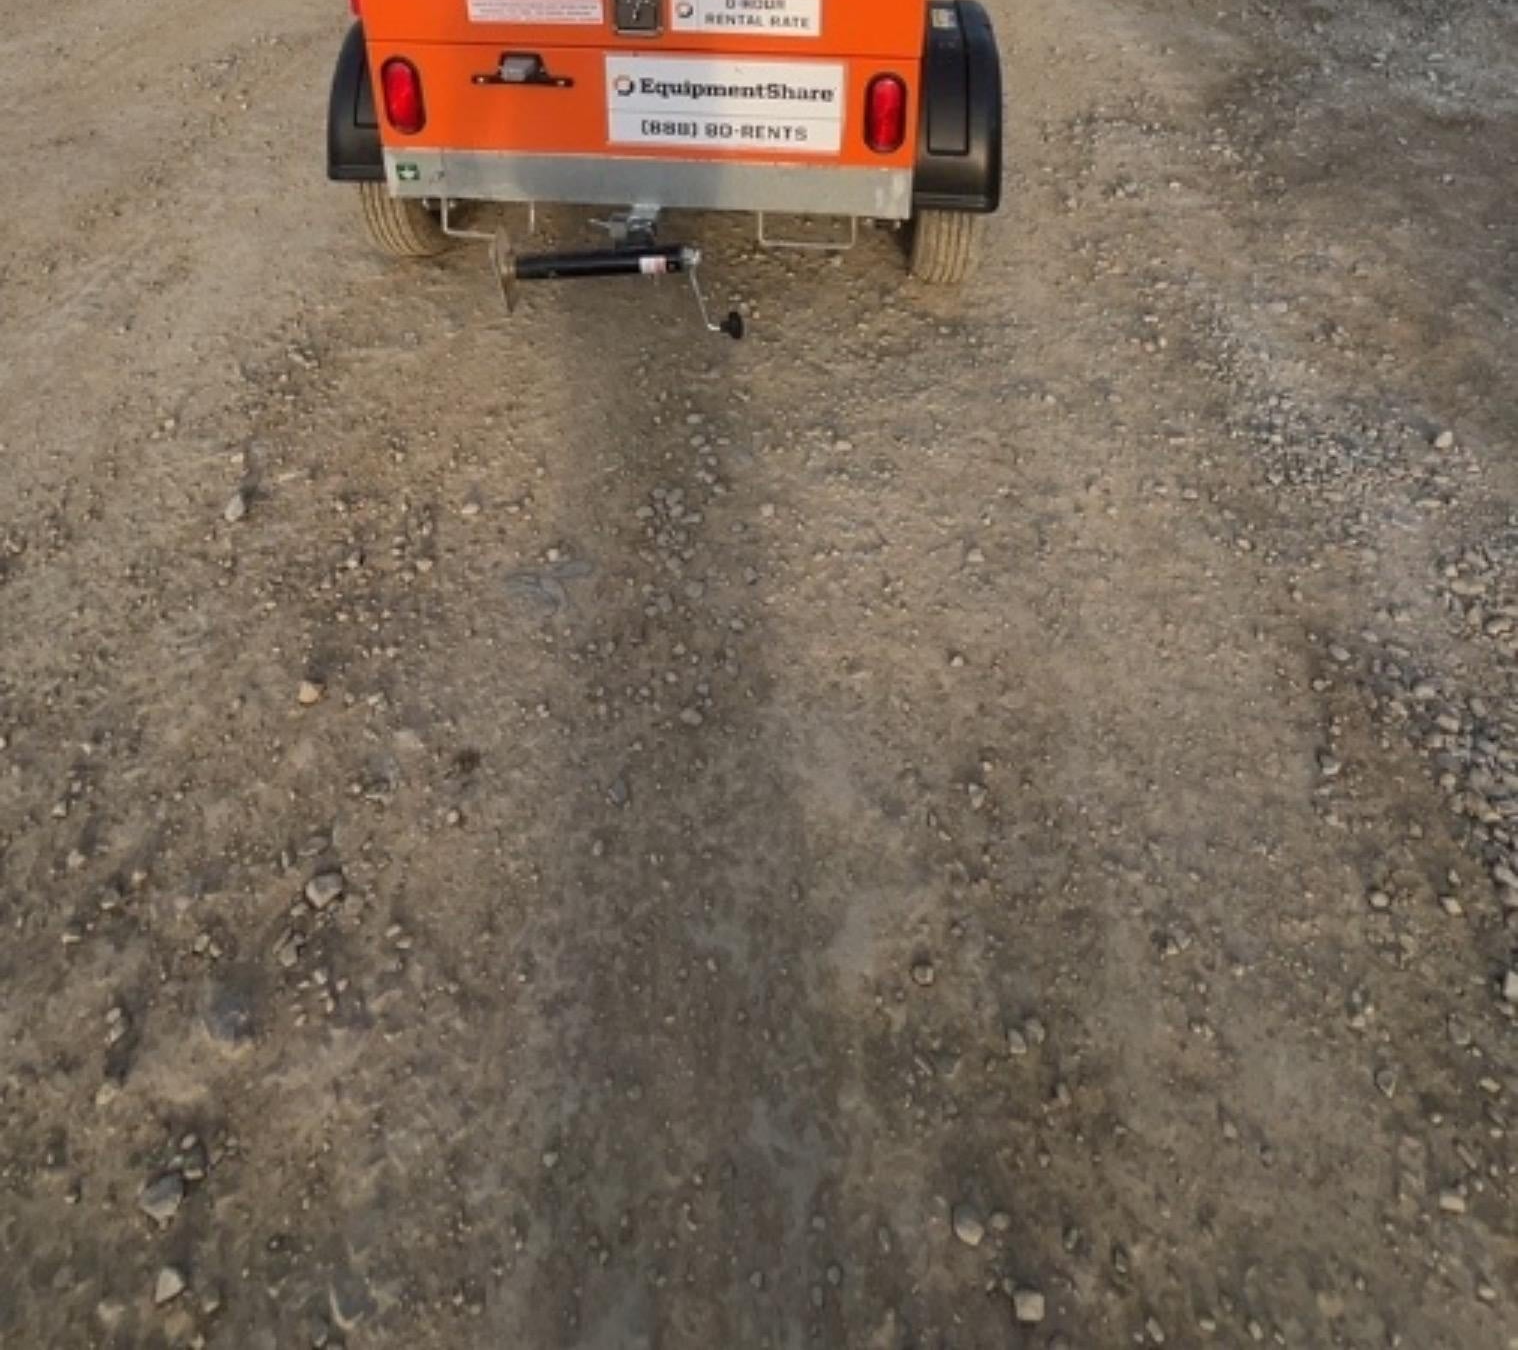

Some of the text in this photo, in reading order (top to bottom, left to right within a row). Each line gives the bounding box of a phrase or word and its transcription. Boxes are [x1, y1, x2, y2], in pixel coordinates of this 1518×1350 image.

[704, 12, 809, 29] RENTAL RATE
[640, 76, 835, 103] EquipmentShare
